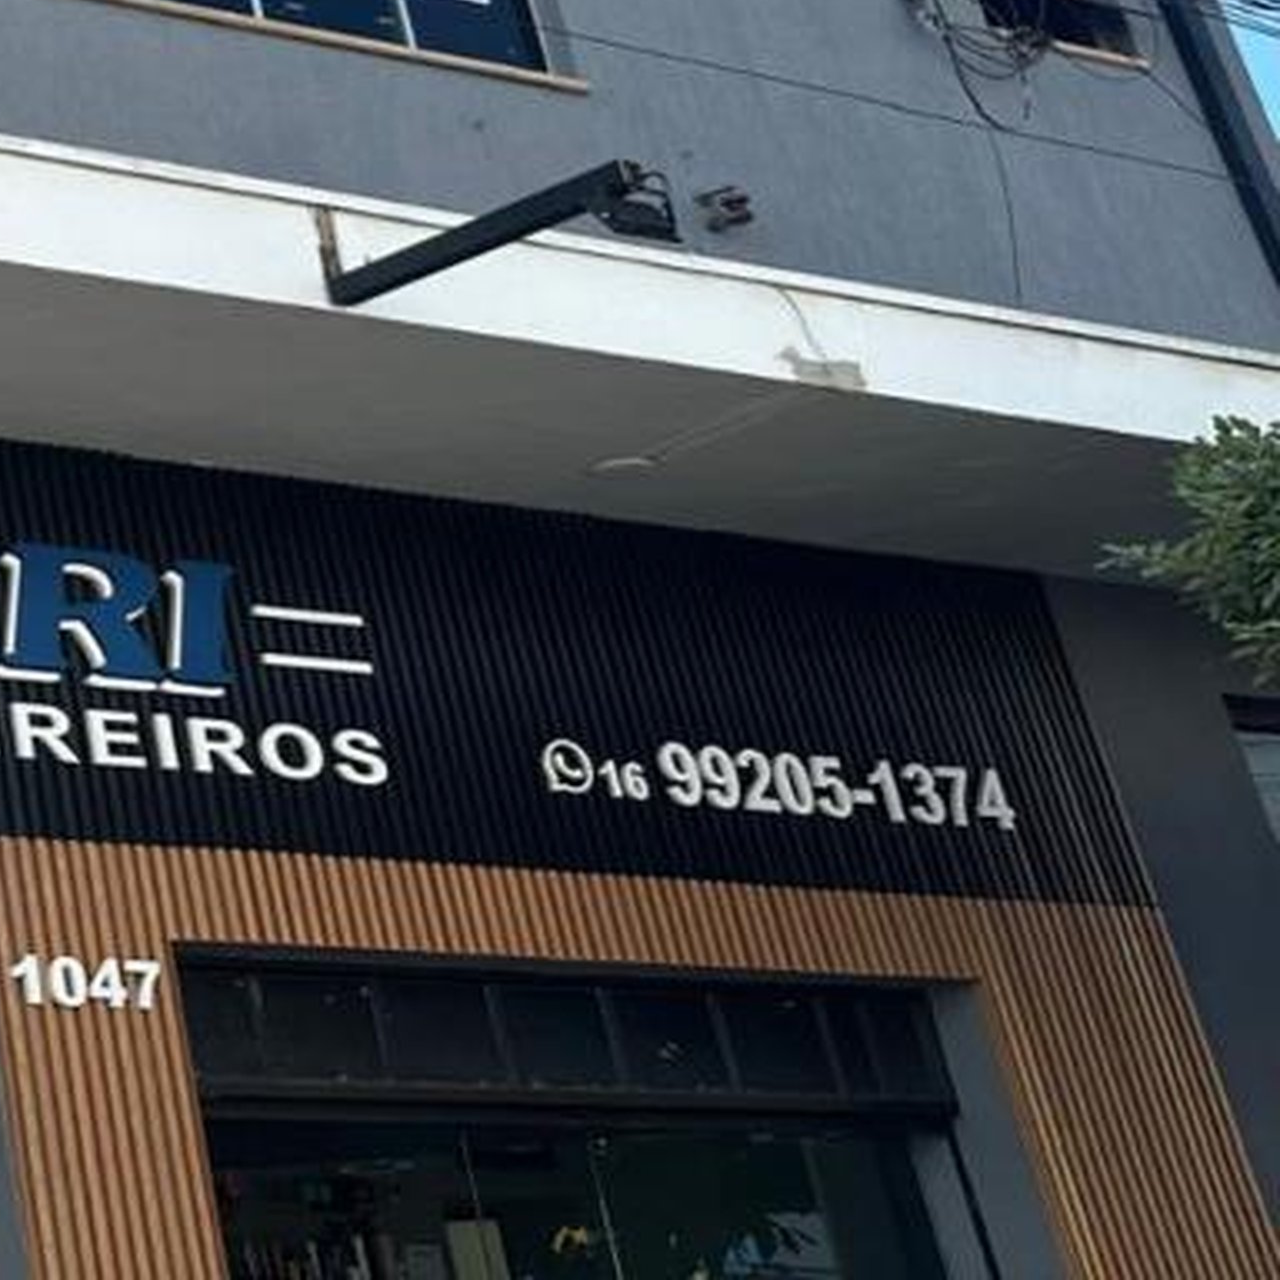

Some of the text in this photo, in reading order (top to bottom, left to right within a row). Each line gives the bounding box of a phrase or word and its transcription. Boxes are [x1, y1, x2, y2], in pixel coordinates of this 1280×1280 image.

[598, 741, 1015, 830] 16 99205-1374
[10, 953, 162, 1011] 1047
